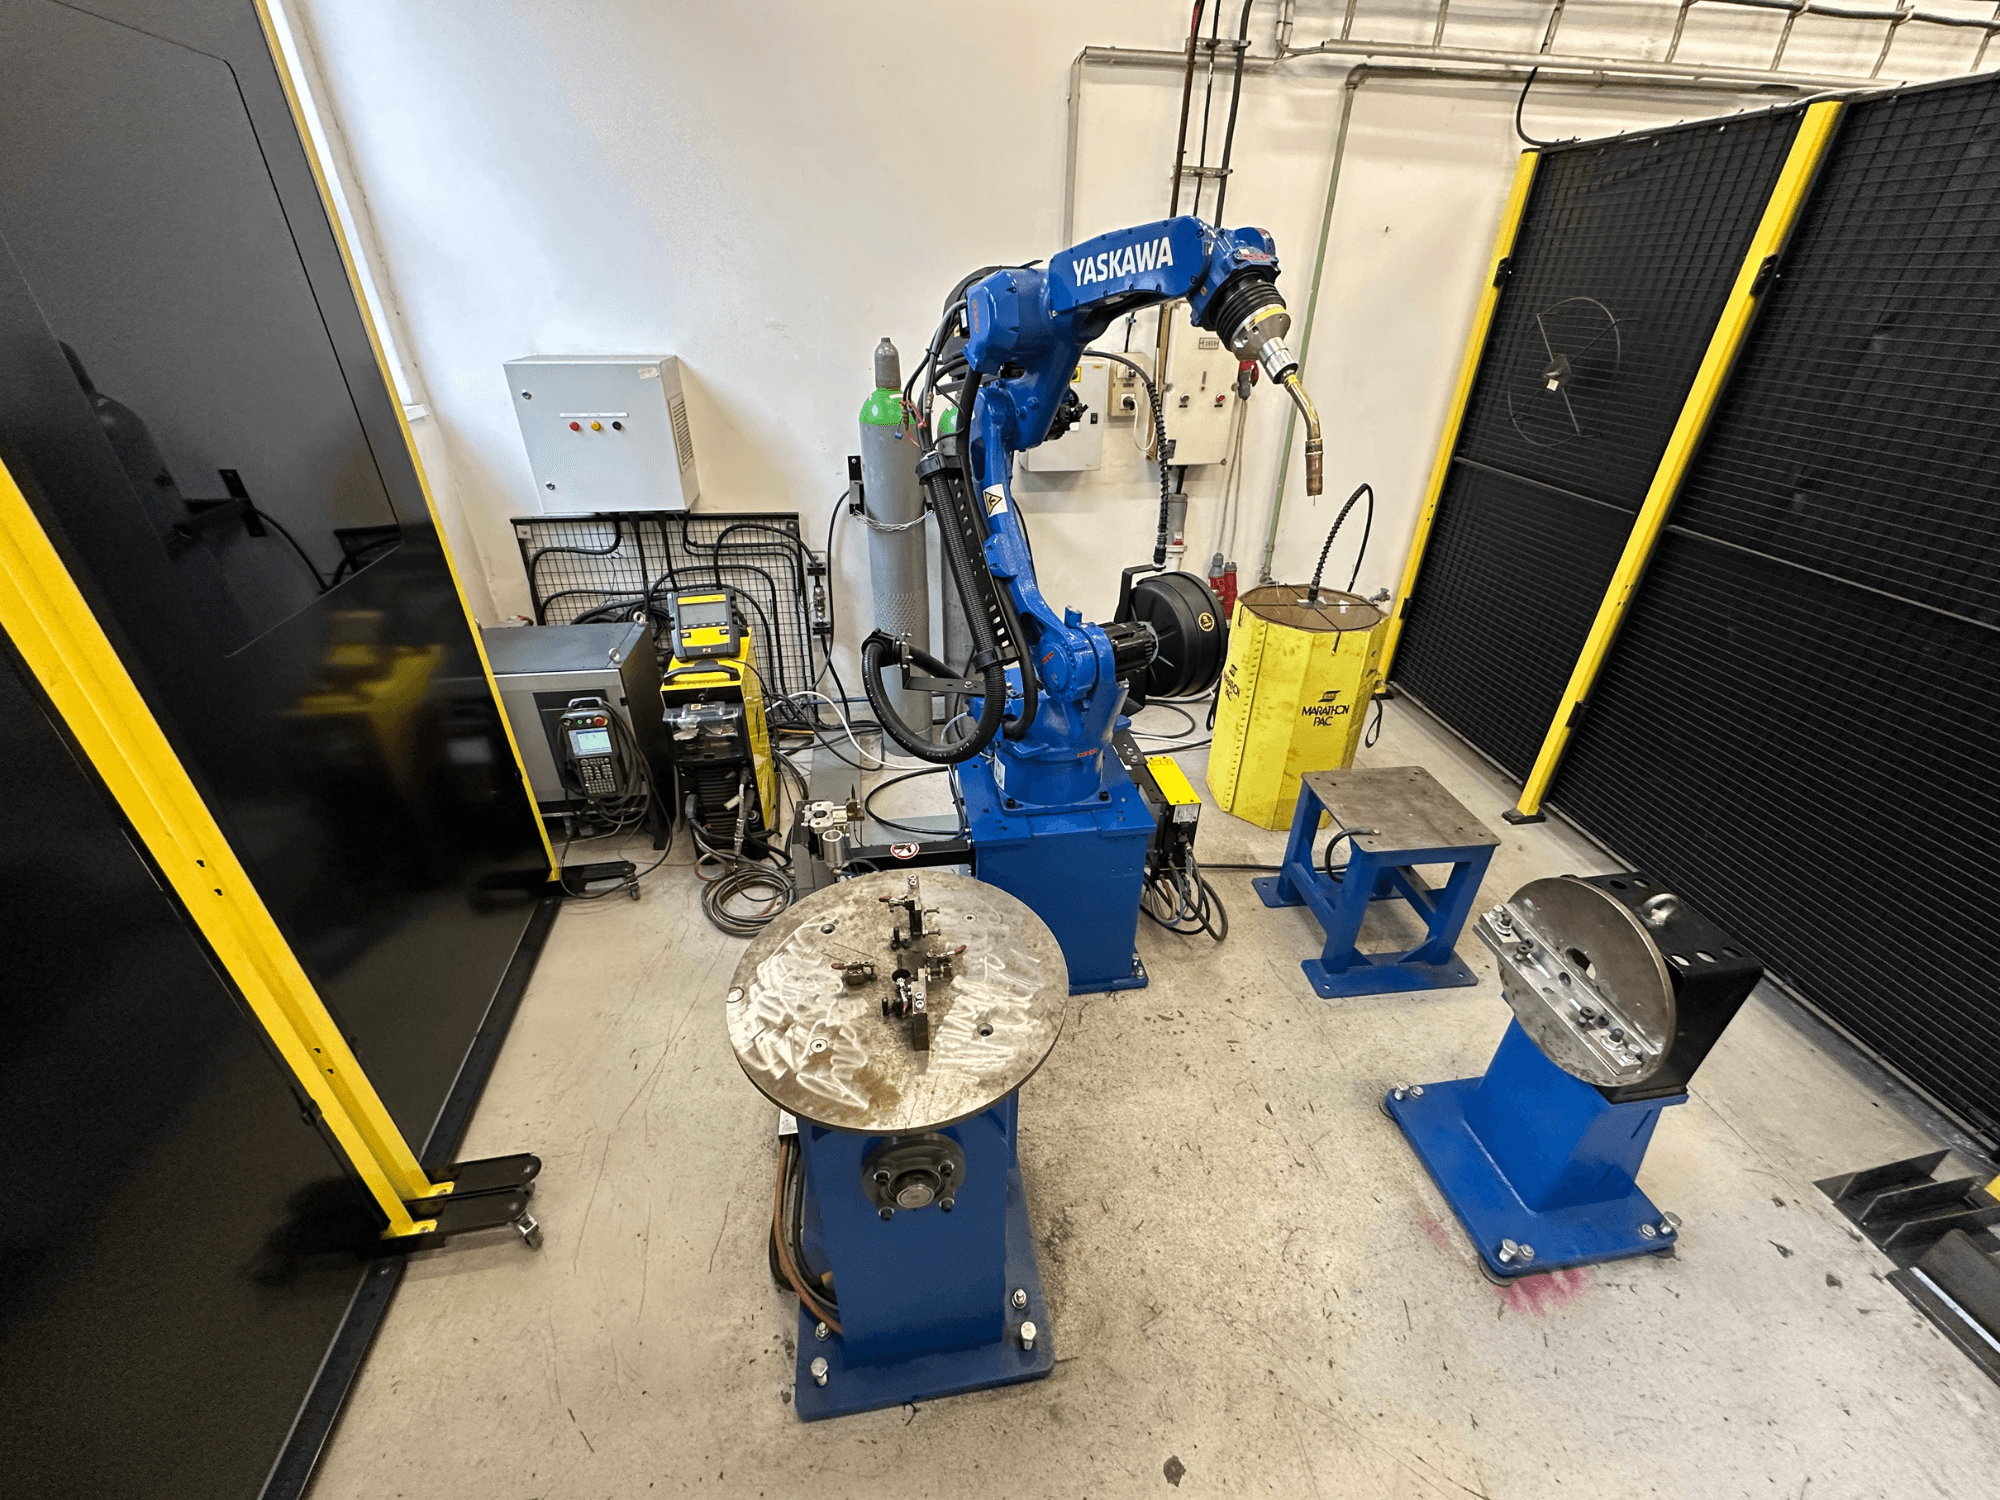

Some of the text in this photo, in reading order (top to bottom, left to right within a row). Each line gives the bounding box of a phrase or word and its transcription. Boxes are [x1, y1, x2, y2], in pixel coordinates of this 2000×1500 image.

[1072, 237, 1174, 287] YASKAWA
[1301, 704, 1350, 716] MARATHON
[1313, 716, 1333, 727] PAC
